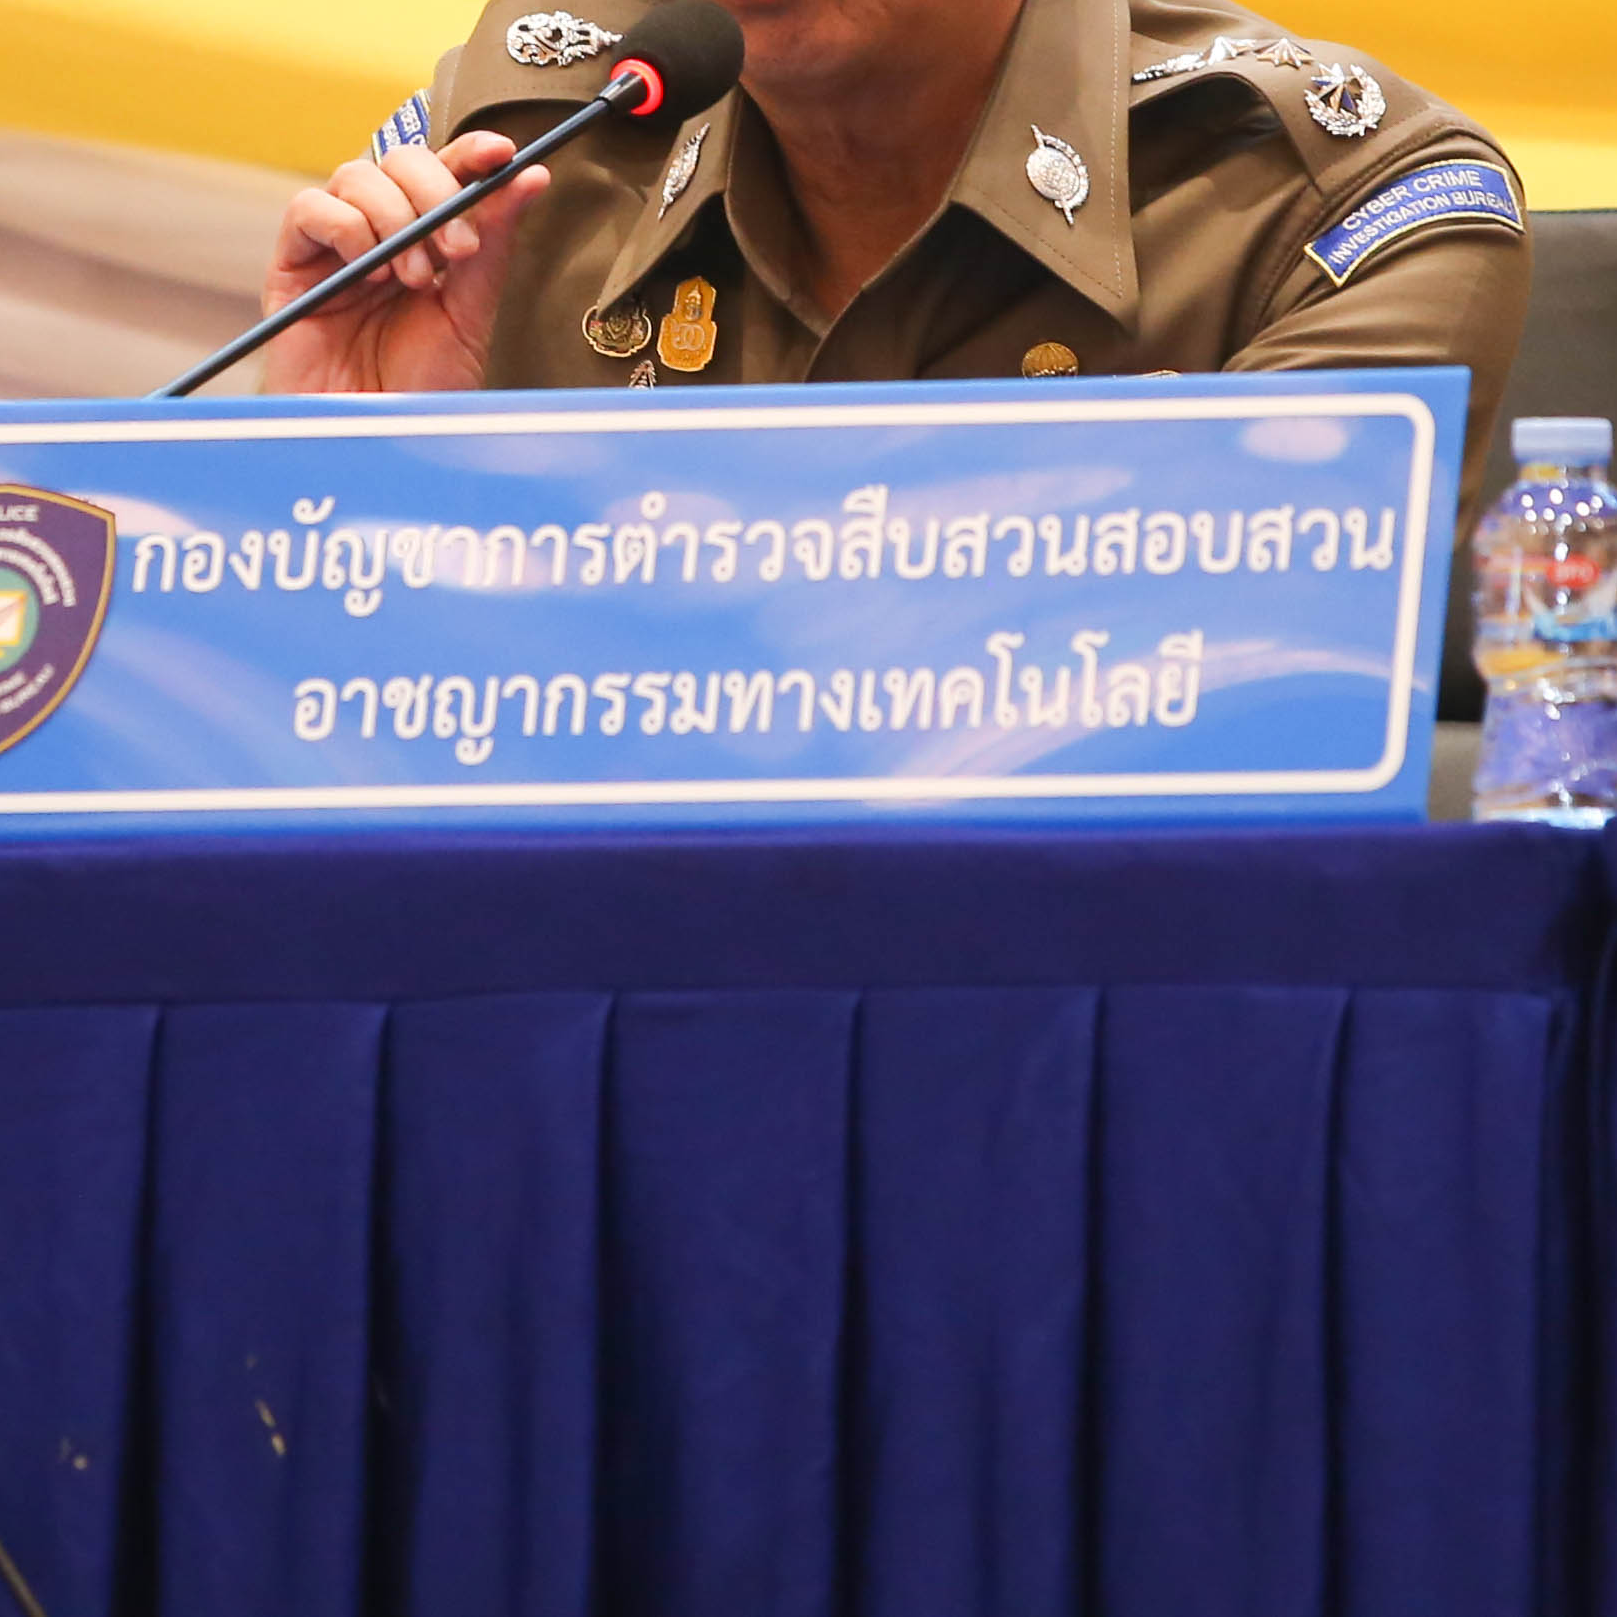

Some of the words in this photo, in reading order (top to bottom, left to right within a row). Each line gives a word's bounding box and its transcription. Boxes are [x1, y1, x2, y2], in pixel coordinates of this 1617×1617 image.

[1328, 192, 1451, 266] INVESTIGATION
[1342, 184, 1413, 230] CYBER
[1412, 170, 1483, 193] CRIME
[132, 483, 1397, 618] กองบัญชาการตำรวจสืบสวนสอบสวน
[291, 626, 1207, 767] อาชญากรรมทางเทคโนโลยี
